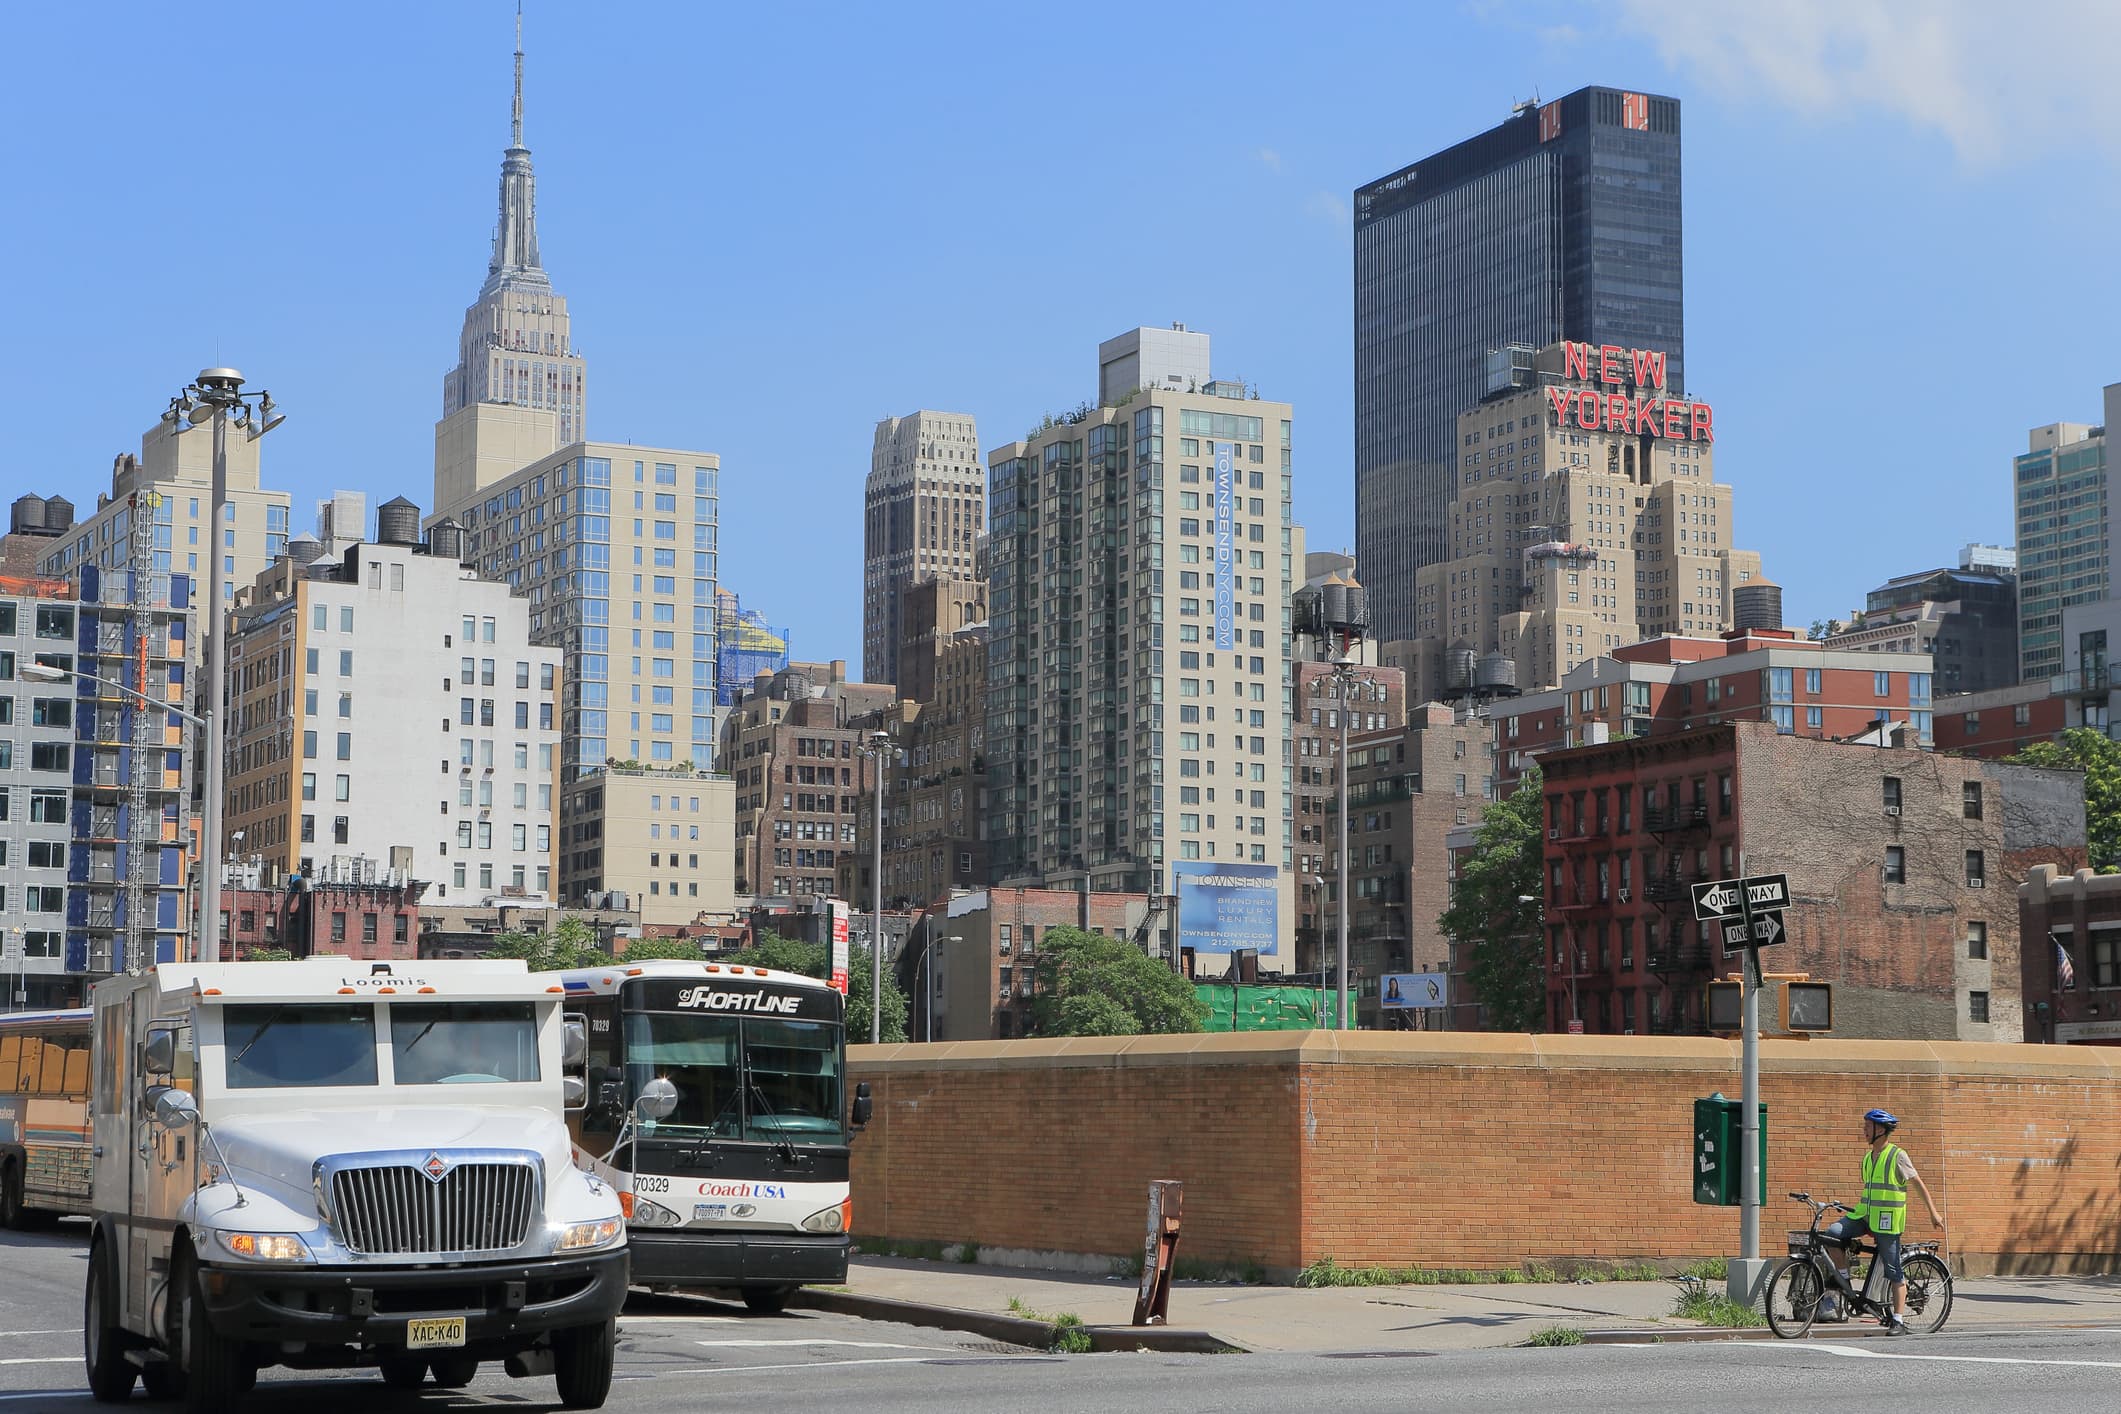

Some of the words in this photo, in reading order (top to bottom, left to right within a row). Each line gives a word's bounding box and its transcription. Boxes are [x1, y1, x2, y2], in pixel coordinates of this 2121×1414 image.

[1565, 340, 1667, 389] NEW
[1549, 386, 1715, 443] YORKER
[1218, 448, 1230, 646] TOWNSENDNYC.COM
[1194, 874, 1274, 889] TOWNSEND
[1217, 897, 1251, 905] BRAND
[1709, 890, 1737, 907] ONE
[1748, 885, 1776, 902] WAY
[1218, 906, 1273, 917] LUXURY
[1182, 930, 1273, 939] OWNSENDNYC.COM
[1730, 926, 1748, 941] ONE
[1756, 921, 1774, 937] WAY
[342, 976, 426, 987] Loomis
[592, 1019, 610, 1032] 70329
[635, 1177, 669, 1193] 70329
[698, 1183, 750, 1198] Coach
[753, 1184, 785, 1199] USA
